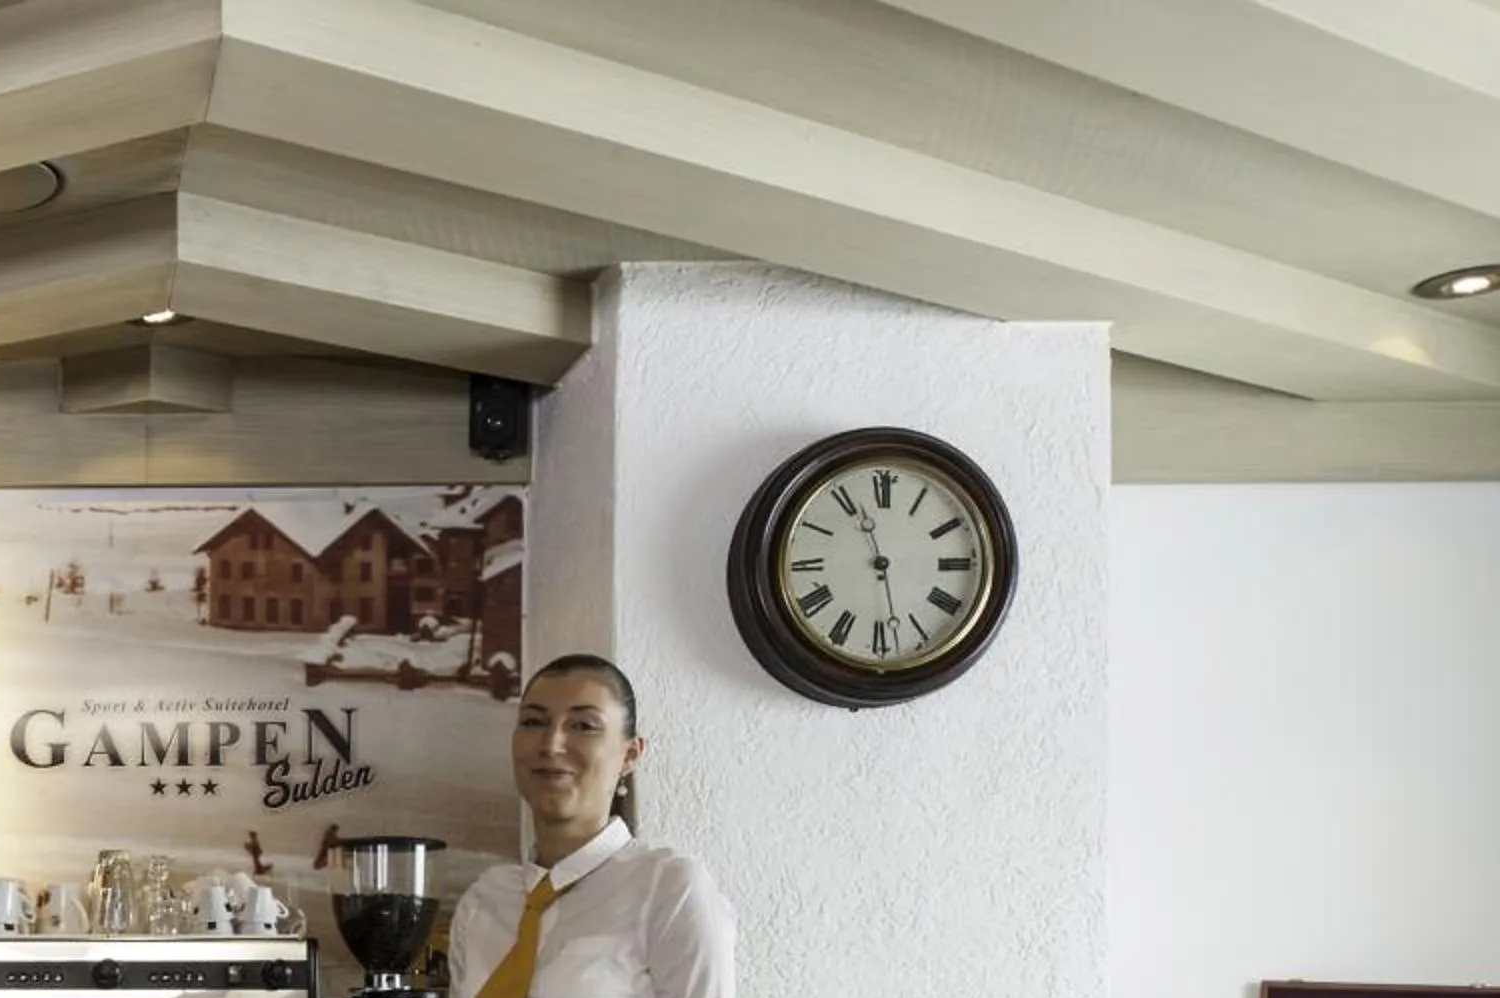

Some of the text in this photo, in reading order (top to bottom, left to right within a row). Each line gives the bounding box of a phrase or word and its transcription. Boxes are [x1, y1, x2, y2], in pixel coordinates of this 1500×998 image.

[80, 698, 128, 716] Sport
[133, 700, 146, 713] &
[201, 697, 291, 713] Suitehotel
[10, 707, 359, 769] GAMPEN
[262, 758, 374, 809] Sulden
